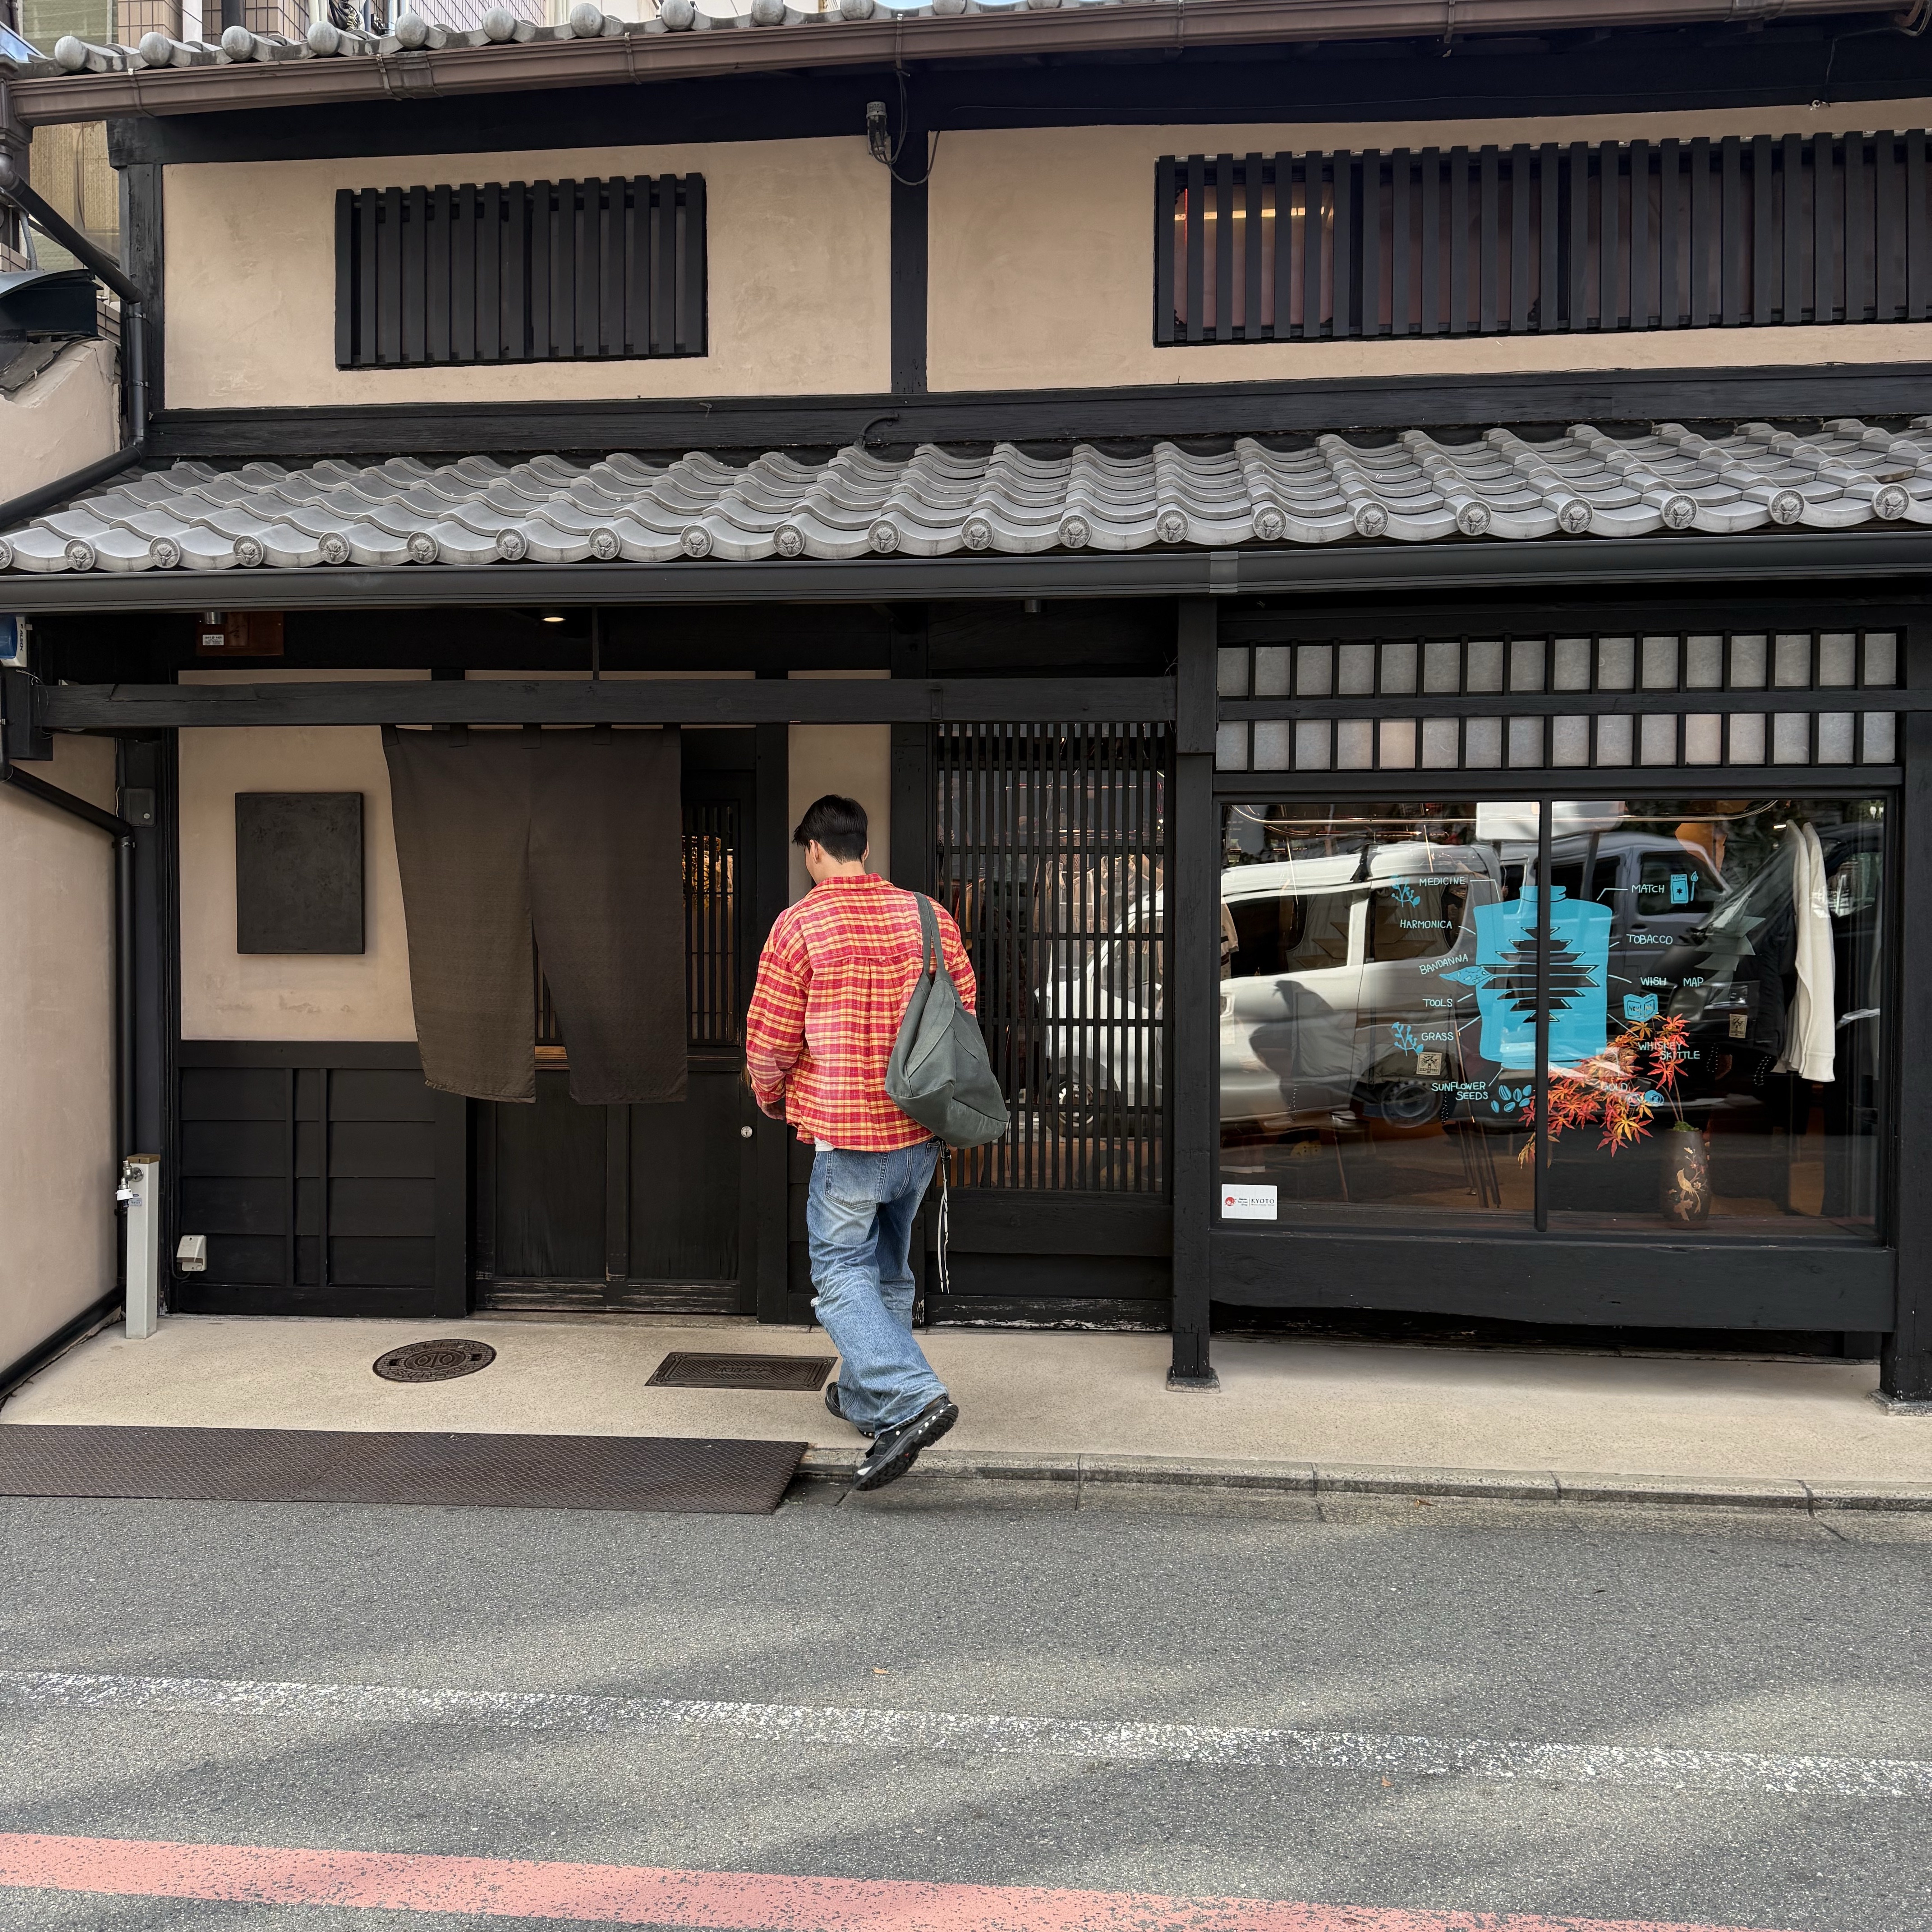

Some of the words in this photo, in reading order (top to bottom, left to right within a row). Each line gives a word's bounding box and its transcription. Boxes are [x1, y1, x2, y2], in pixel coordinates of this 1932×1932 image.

[1419, 876, 1466, 887] MEDICINE
[1632, 884, 1665, 893] MATCH
[1400, 919, 1453, 929] HARMONICA
[1626, 934, 1673, 945] TOBACCO
[1419, 953, 1468, 975] BANDANNA
[1640, 977, 1666, 986] WISH
[1683, 977, 1704, 987] MAP
[1422, 998, 1453, 1007] TOOLS
[1421, 1032, 1454, 1041] GRASS
[1638, 1041, 1683, 1051] WHISKEY
[1431, 1081, 1486, 1091] SUNFLOWER
[1455, 1091, 1488, 1100] SEEDS
